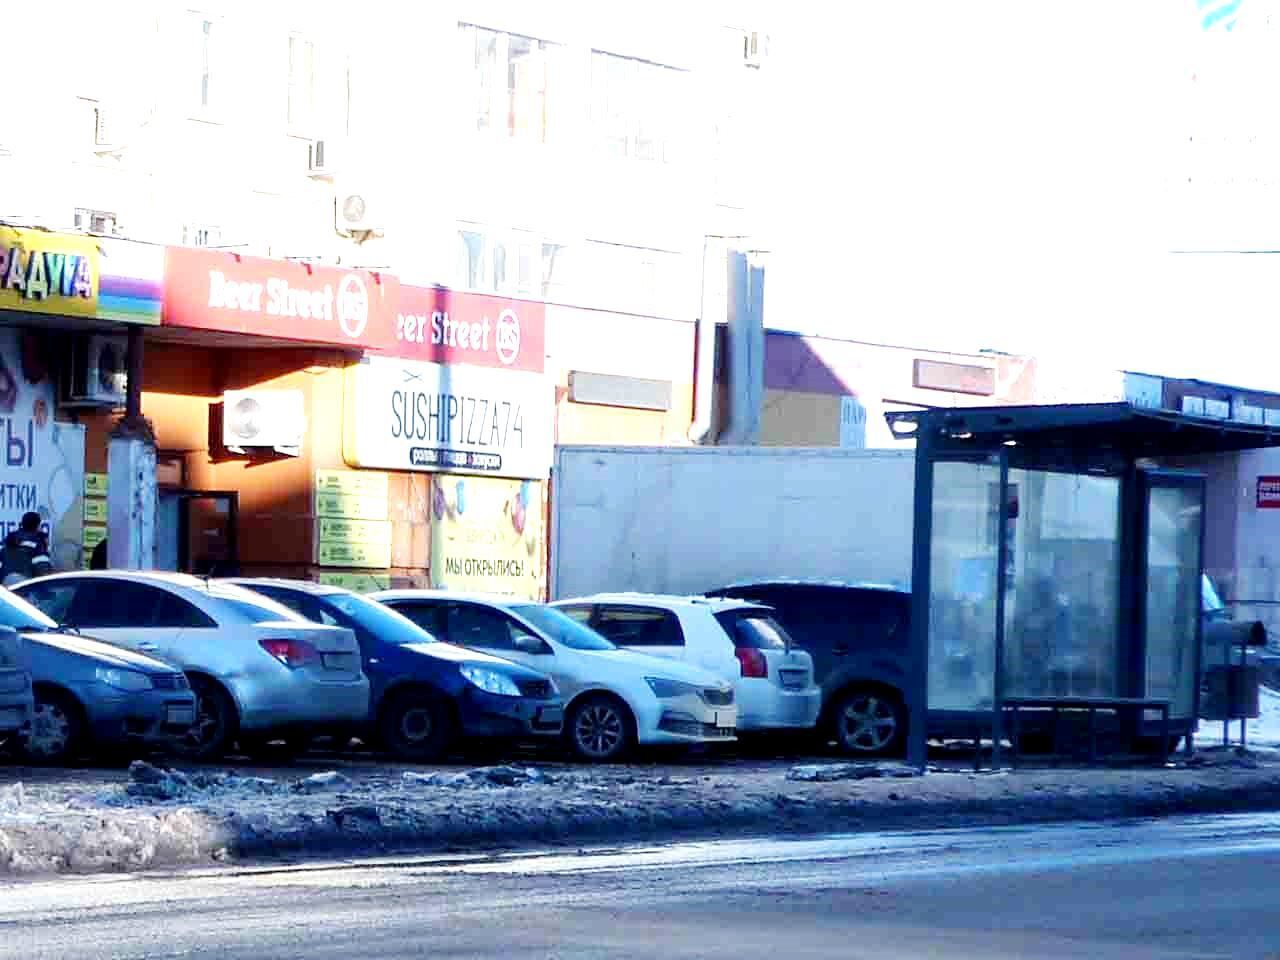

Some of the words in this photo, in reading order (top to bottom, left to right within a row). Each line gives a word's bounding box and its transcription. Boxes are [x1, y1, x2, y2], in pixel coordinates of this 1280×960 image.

[208, 270, 262, 312] Beer
[266, 277, 334, 320] Street
[431, 311, 491, 351] Street
[445, 557, 463, 575] МЫ
[464, 558, 524, 577] ОТКРЫЛИСЬ!
